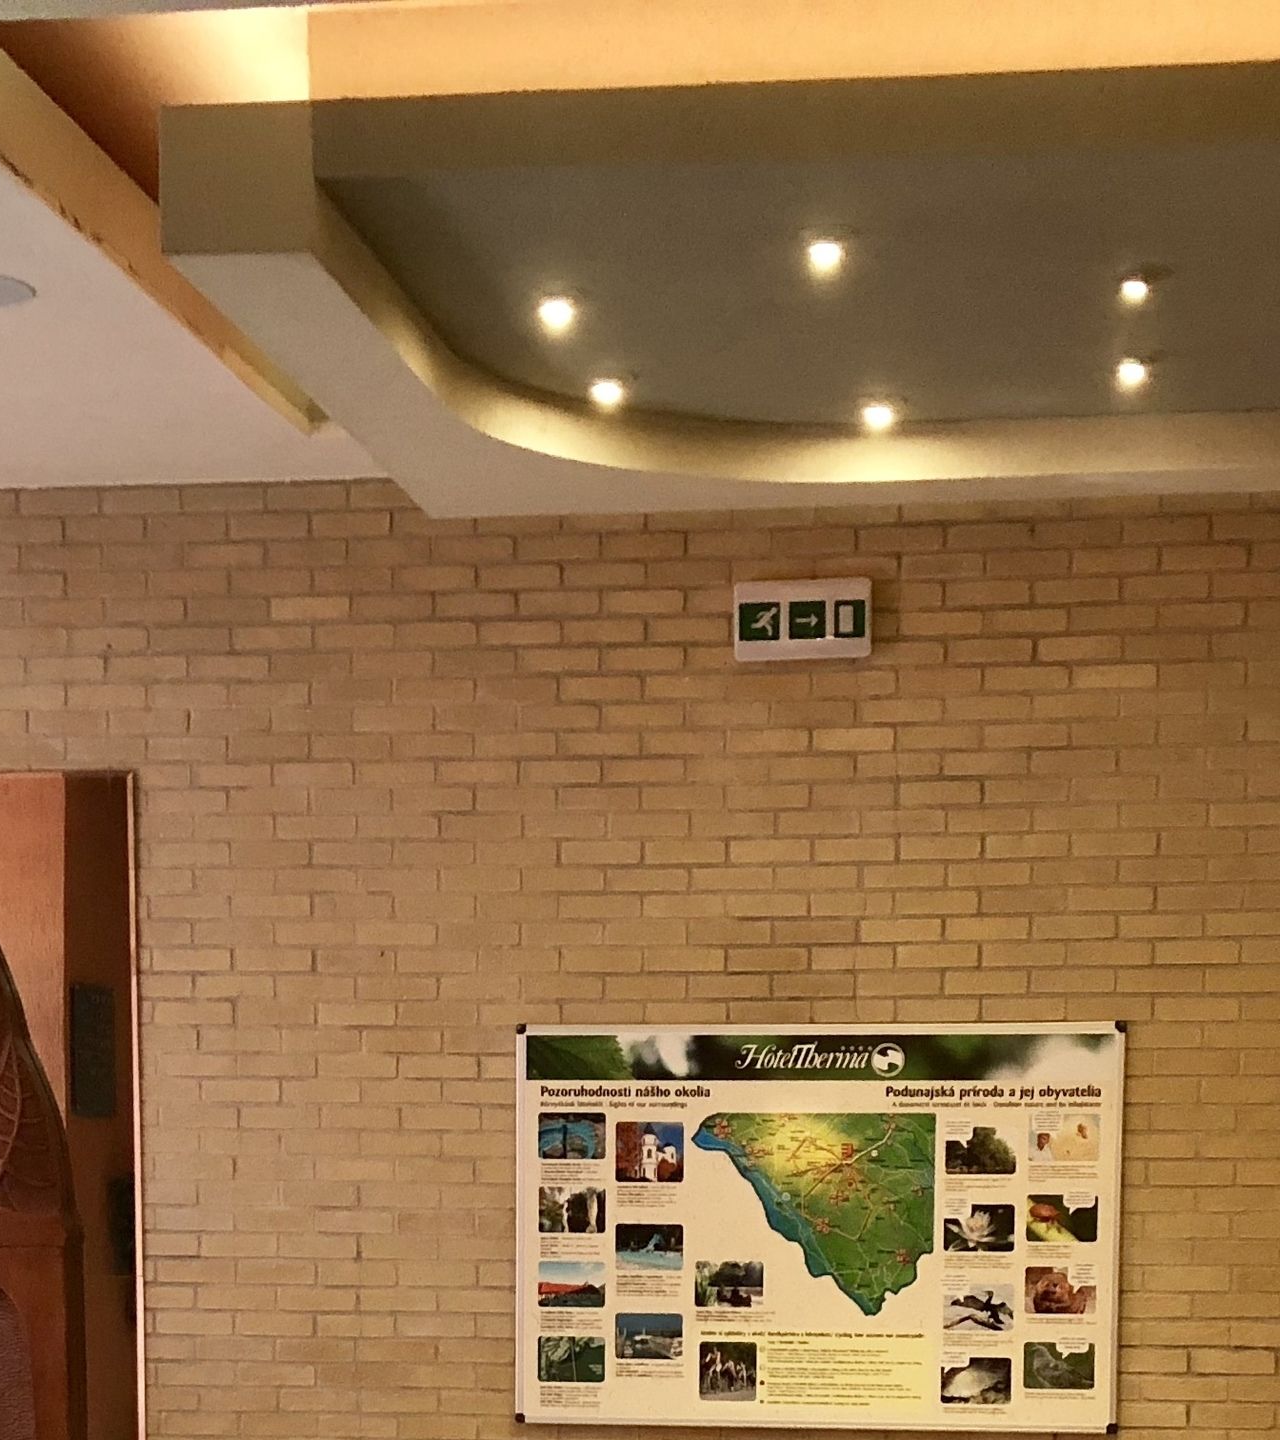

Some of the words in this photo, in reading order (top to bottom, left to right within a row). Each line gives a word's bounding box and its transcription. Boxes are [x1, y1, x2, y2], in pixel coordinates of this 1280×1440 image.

[734, 1043, 798, 1070] Hotel
[793, 1040, 870, 1070] Therma
[540, 1085, 631, 1098] Pozoruhodnosti
[635, 1085, 671, 1098] nášho
[674, 1085, 711, 1098] okolia
[885, 1085, 955, 1100] Podunajská
[959, 1085, 1005, 1100] príroda
[1008, 1089, 1016, 1097] a
[1019, 1086, 1035, 1100] jej
[1038, 1085, 1102, 1100] obyvatelia
